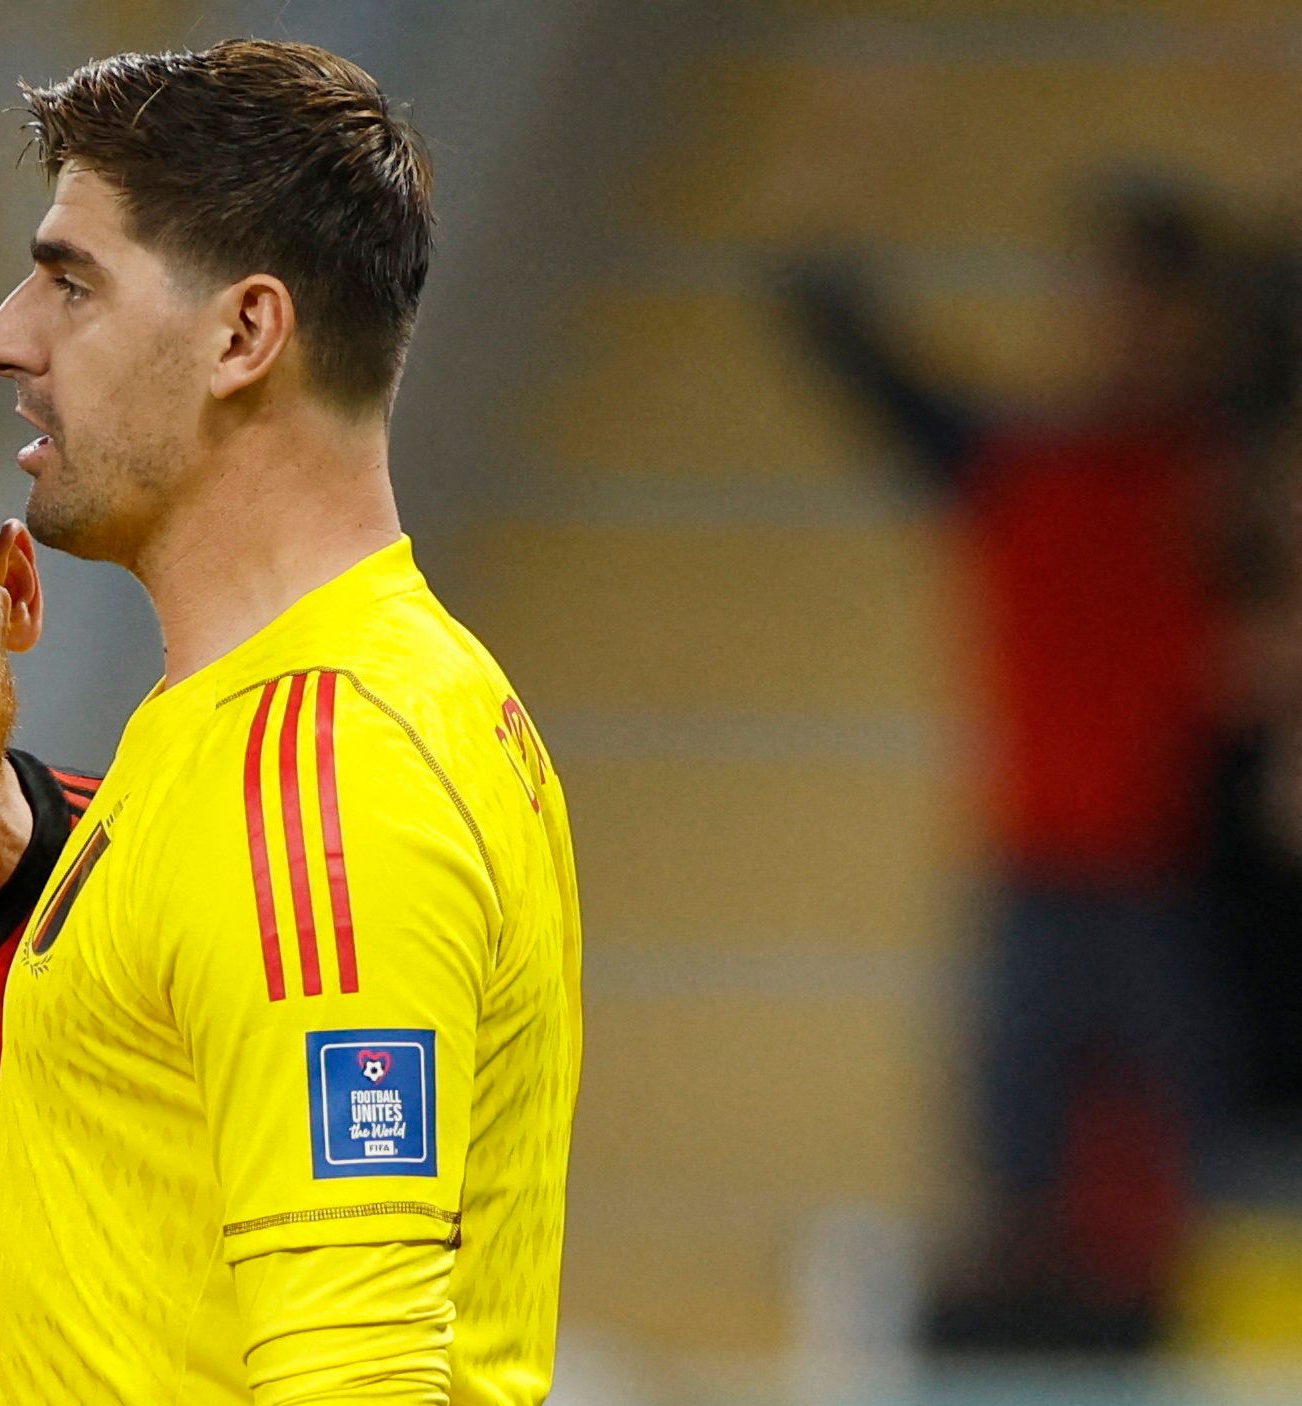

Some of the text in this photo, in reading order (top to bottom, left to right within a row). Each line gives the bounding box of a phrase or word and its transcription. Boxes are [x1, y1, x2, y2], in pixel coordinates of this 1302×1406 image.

[351, 1090, 402, 1104] FOOTBALL
[352, 1104, 403, 1122] UNITES
[349, 1122, 406, 1140] the World
[369, 1144, 390, 1152] FIFA
